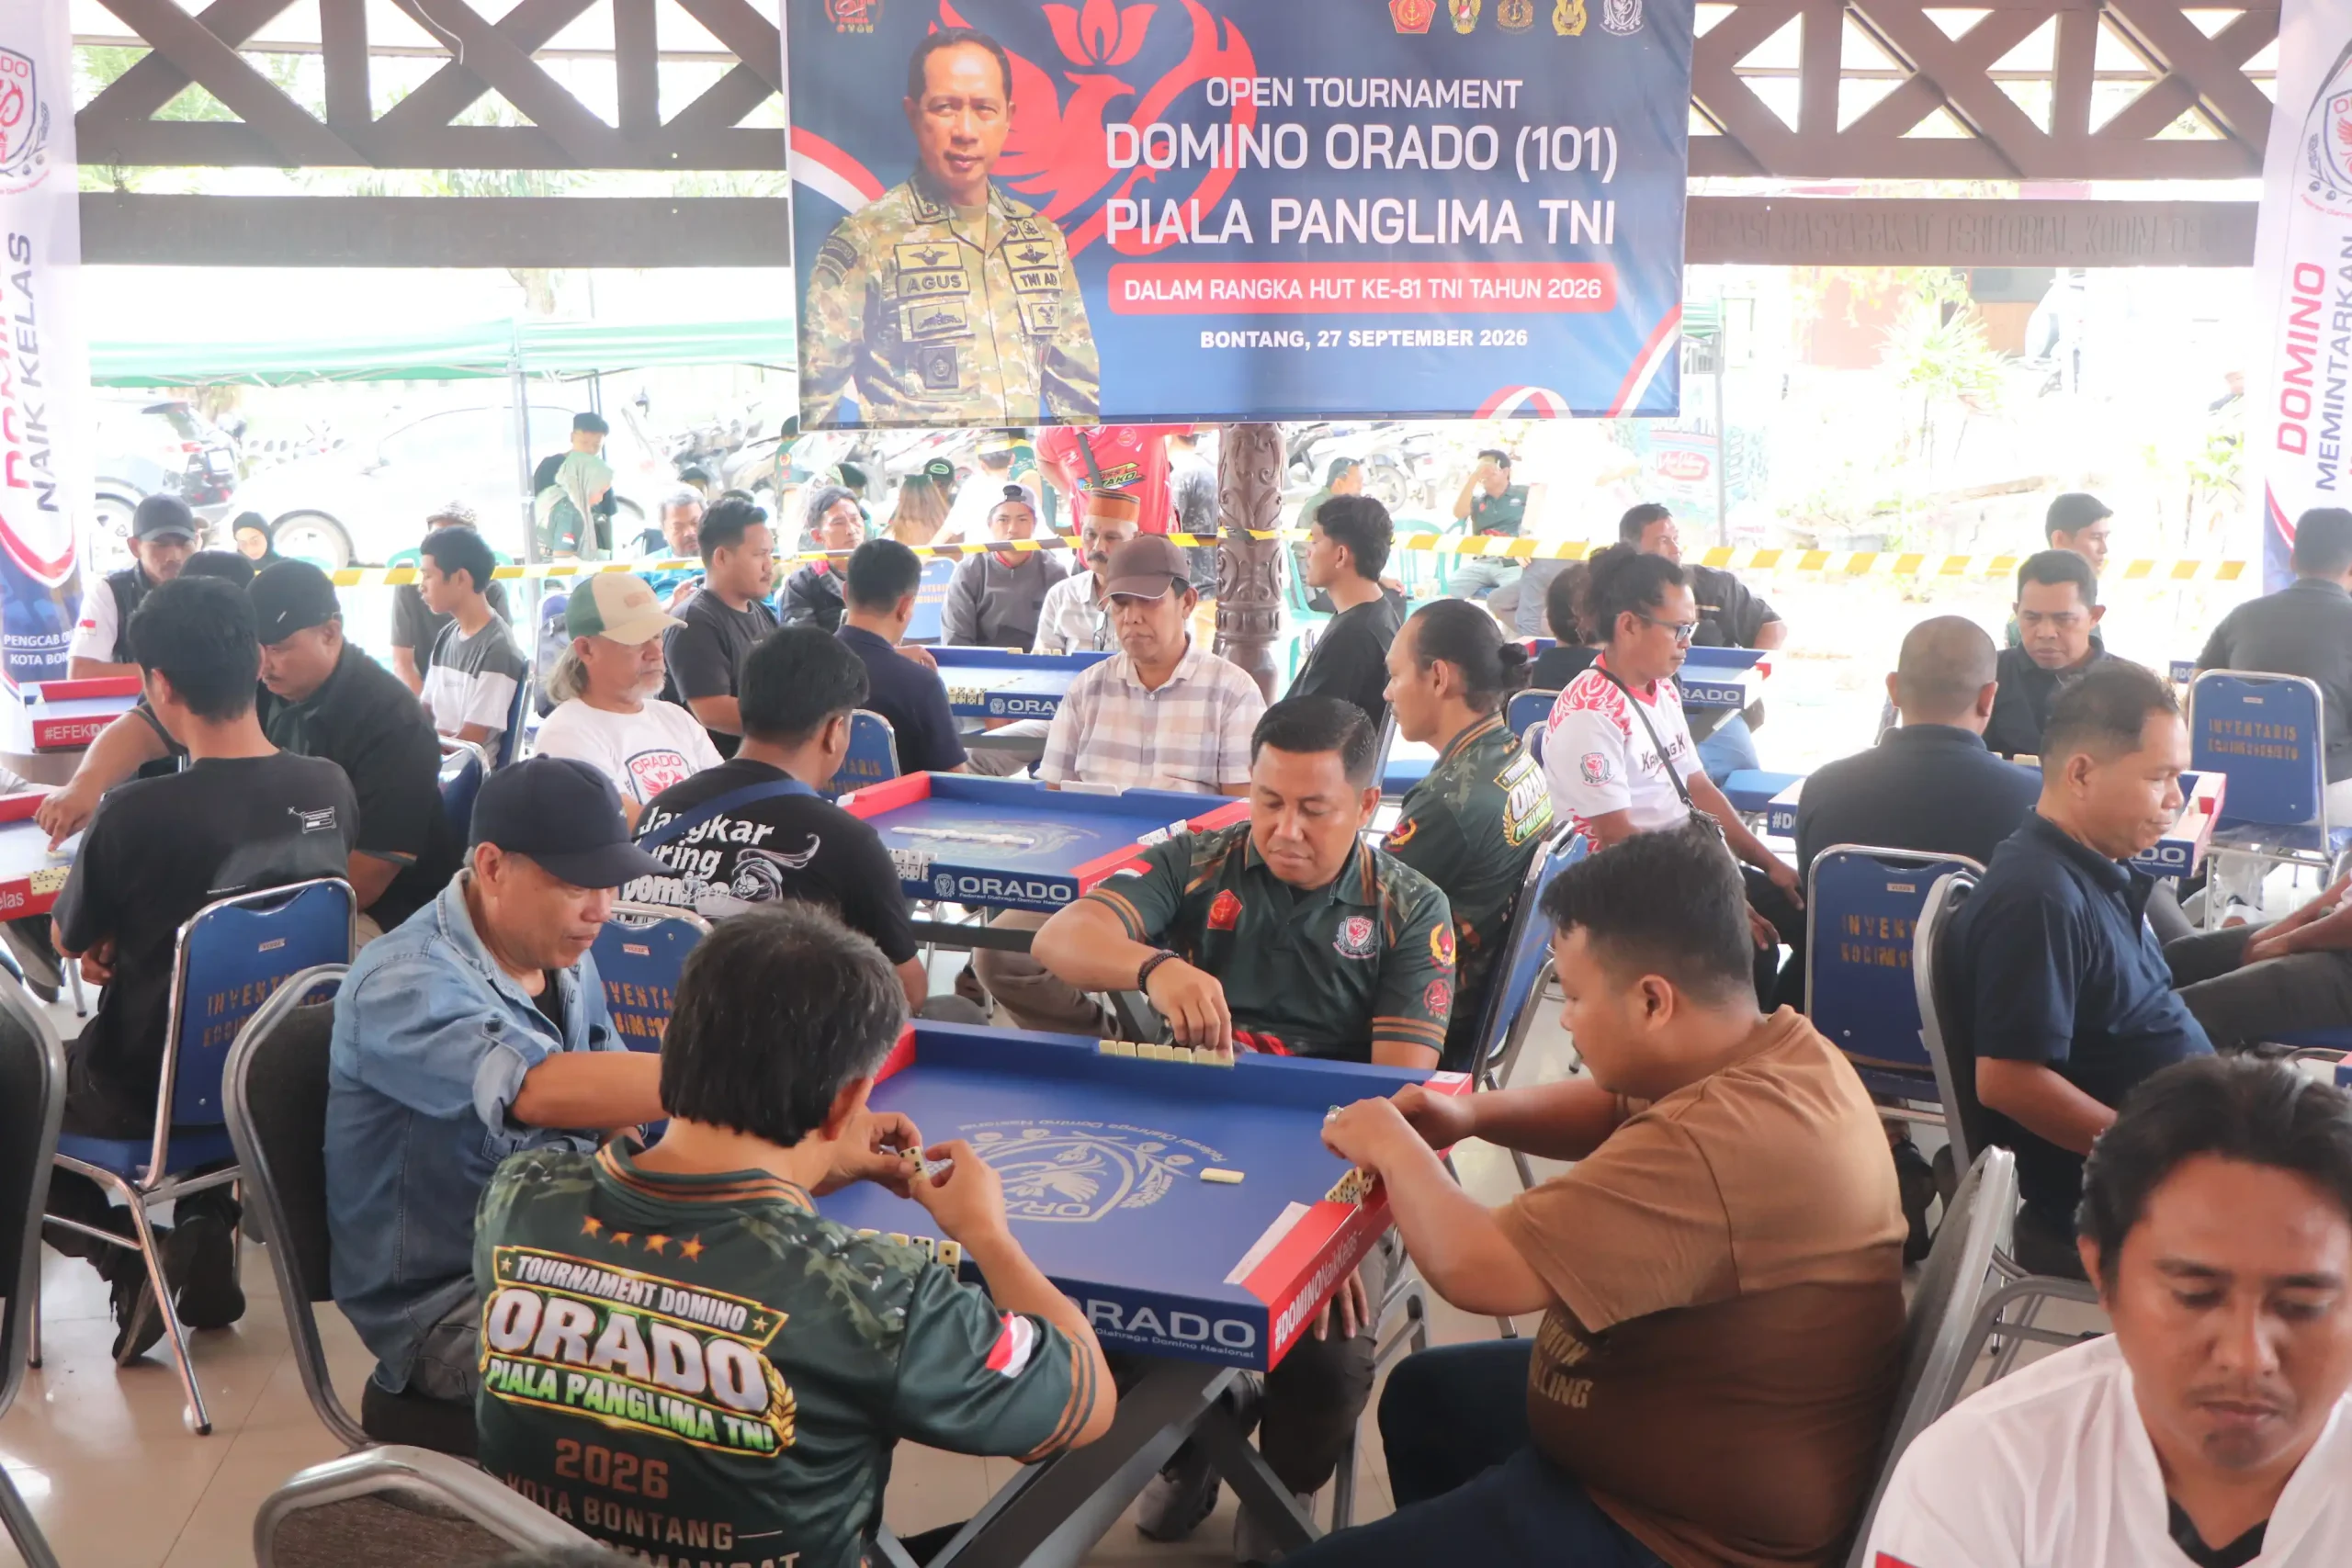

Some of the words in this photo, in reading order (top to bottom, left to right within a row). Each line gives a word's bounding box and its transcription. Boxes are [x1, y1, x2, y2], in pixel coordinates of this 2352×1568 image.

[1206, 77, 1293, 107] OPEN
[1304, 78, 1523, 109] TOURNAMENT
[1106, 123, 1308, 169] DOMINO
[1325, 124, 1498, 170] ORADO
[1515, 125, 1617, 184] (101)
[1106, 198, 1253, 244] PIALA
[1271, 198, 1523, 244] PANGLIMA
[1539, 199, 1615, 244] TNI
[906, 275, 962, 292] AGUS
[1020, 274, 1042, 288] TNI
[1045, 273, 1057, 286] AD
[1125, 279, 1203, 300] DALAM
[1210, 279, 1303, 299] RANGKA
[1309, 279, 1355, 299] HUT
[1362, 278, 1421, 299] KE-81
[1428, 278, 1463, 299] TNI
[1469, 278, 1542, 299] TAHUN
[1547, 278, 1601, 299] 2026
[8, 232, 42, 388] KELAS
[1200, 331, 1311, 351] BONTANG,
[1317, 331, 1341, 347] 27
[1348, 329, 1474, 348] SEPTEMBER
[1479, 329, 1528, 346] 2026
[2276, 262, 2325, 456] DOMINO
[23, 400, 60, 513] NAIK
[4, 634, 60, 647] PENGCAB
[10, 654, 43, 666] KOTA
[1008, 699, 1061, 712] ORA
[1682, 688, 1740, 702] RADO
[631, 754, 682, 775] ORADO
[638, 806, 775, 846] Jagkar
[958, 876, 1072, 901] ORADO
[515, 1255, 658, 1307] TOURNAMENT
[659, 1286, 748, 1331] DOMINO
[1066, 1295, 1256, 1348] RADO
[488, 1288, 769, 1412] ORADO
[1152, 1335, 1197, 1350] Domino
[1200, 1344, 1254, 1359] Nasional
[486, 1359, 558, 1401] PIALA
[565, 1373, 718, 1443] PANGLIMA
[722, 1415, 775, 1451] TNI
[555, 1439, 670, 1499] 2026
[583, 1495, 732, 1551] BONTANG
